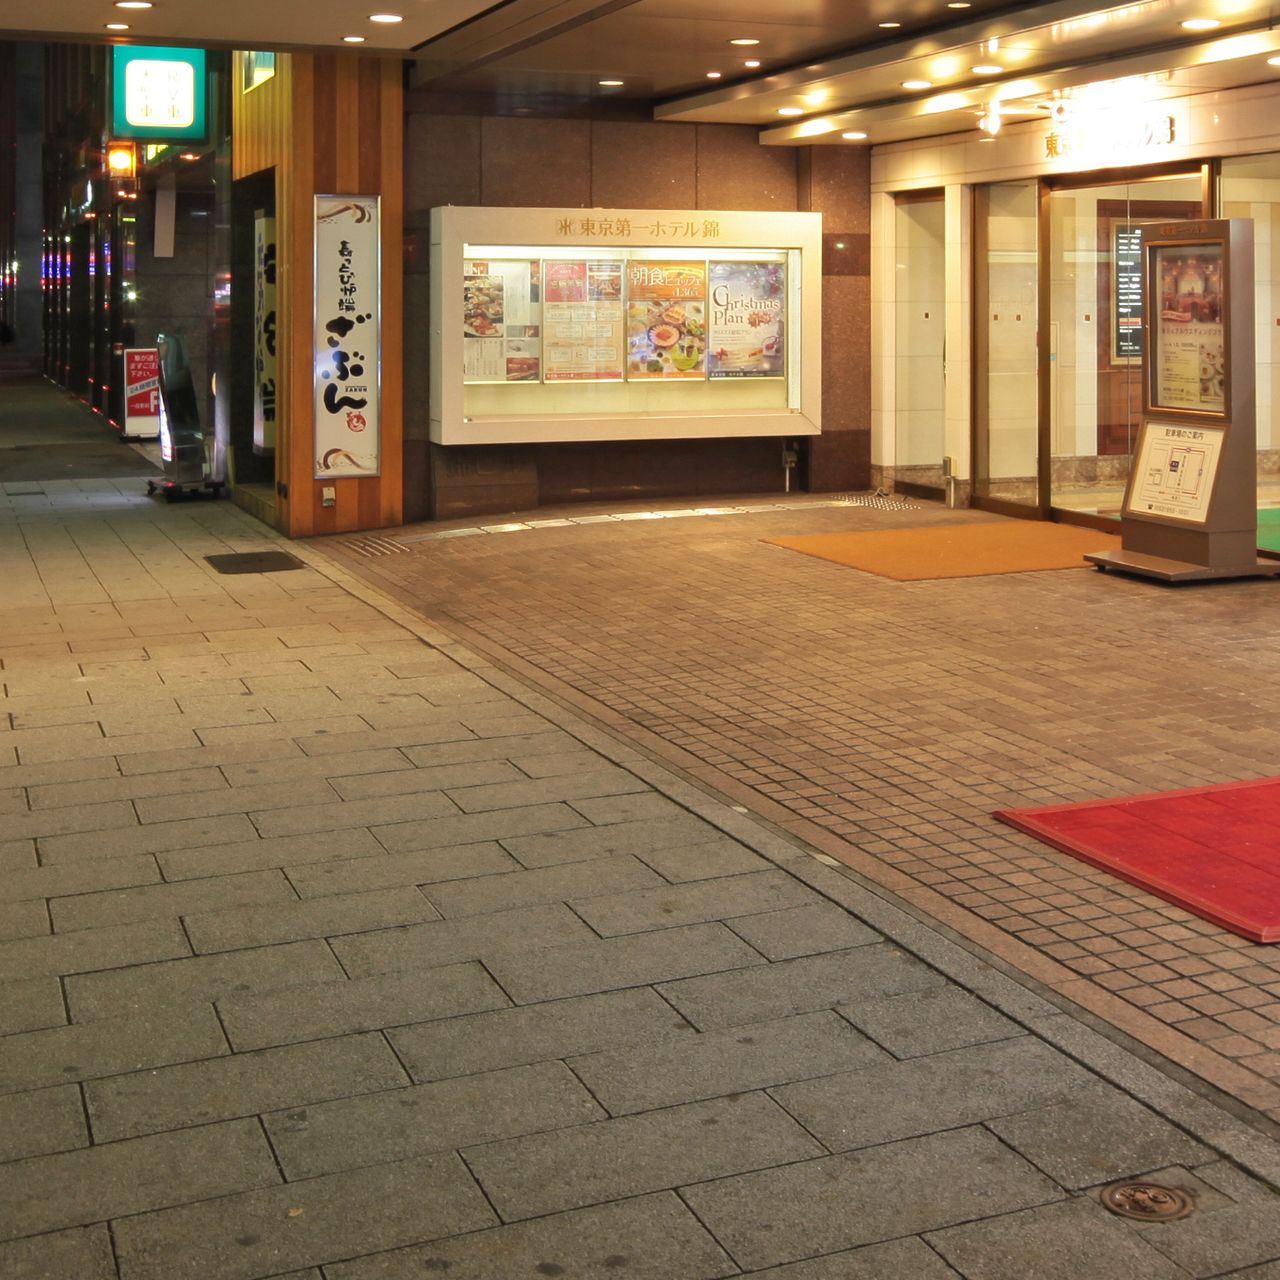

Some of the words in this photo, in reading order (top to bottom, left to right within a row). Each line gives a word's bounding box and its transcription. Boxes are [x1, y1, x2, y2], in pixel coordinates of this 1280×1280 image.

[579, 217, 720, 239] 東京第一ホテル錦
[631, 265, 704, 288] 朝食ビュッフェ
[712, 285, 780, 311] Christmas
[713, 310, 744, 326] Plan
